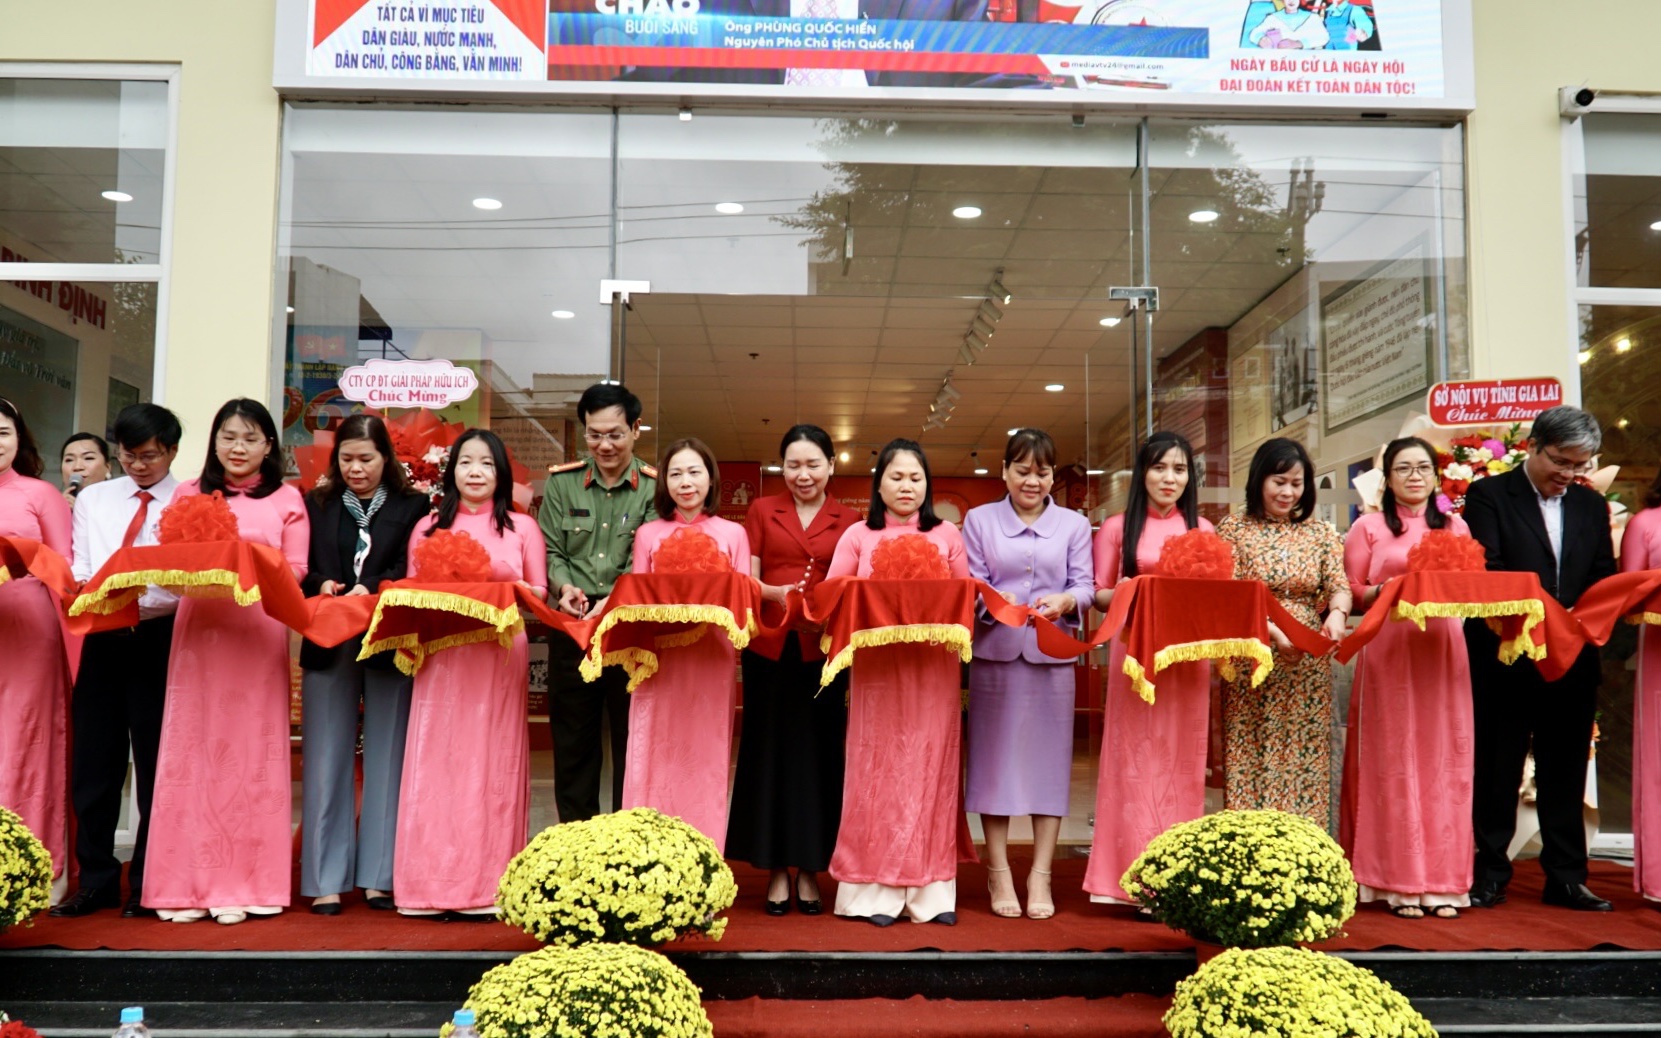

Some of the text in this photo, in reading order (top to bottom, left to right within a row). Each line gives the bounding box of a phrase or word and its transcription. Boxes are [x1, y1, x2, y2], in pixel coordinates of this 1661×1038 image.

[377, 0, 485, 26] TẤT CẢ VÌ MỤC TIÊU
[724, 21, 752, 34] Ông
[754, 20, 802, 33] PHÙNG
[804, 21, 843, 34] QUỐC
[362, 27, 386, 46] DÂN
[390, 28, 420, 48] GIÀU,
[424, 26, 455, 47] NƯỚC
[724, 36, 915, 52] Nguyên Phó Chủ tịch Quốc hội
[335, 50, 359, 69] DÂN
[362, 48, 387, 71] CHỦ,
[392, 51, 422, 70] CÔNG
[489, 57, 522, 72] MINH!
[1230, 56, 1266, 71] NGÀY
[1301, 55, 1320, 73] CỬ
[1323, 57, 1339, 73] LÀ
[1343, 58, 1378, 74] NGÀY
[1383, 59, 1405, 77] HỘI
[1219, 79, 1242, 94] ĐẠI
[1246, 77, 1283, 92] ĐOÀN
[1287, 76, 1310, 93] KẾT
[1316, 78, 1350, 94] TOÀN
[1354, 78, 1382, 95] DÂN
[348, 375, 363, 388] CTY
[366, 375, 376, 388] CP
[378, 375, 389, 388] ĐT
[410, 372, 432, 388] PHÁP
[454, 373, 469, 388] ÍCH
[368, 389, 448, 404] Chúc Mừng
[1434, 379, 1560, 410] SỞ NỘI VỤ TỈNH GIA LAI
[1446, 408, 1489, 422] Chúc
